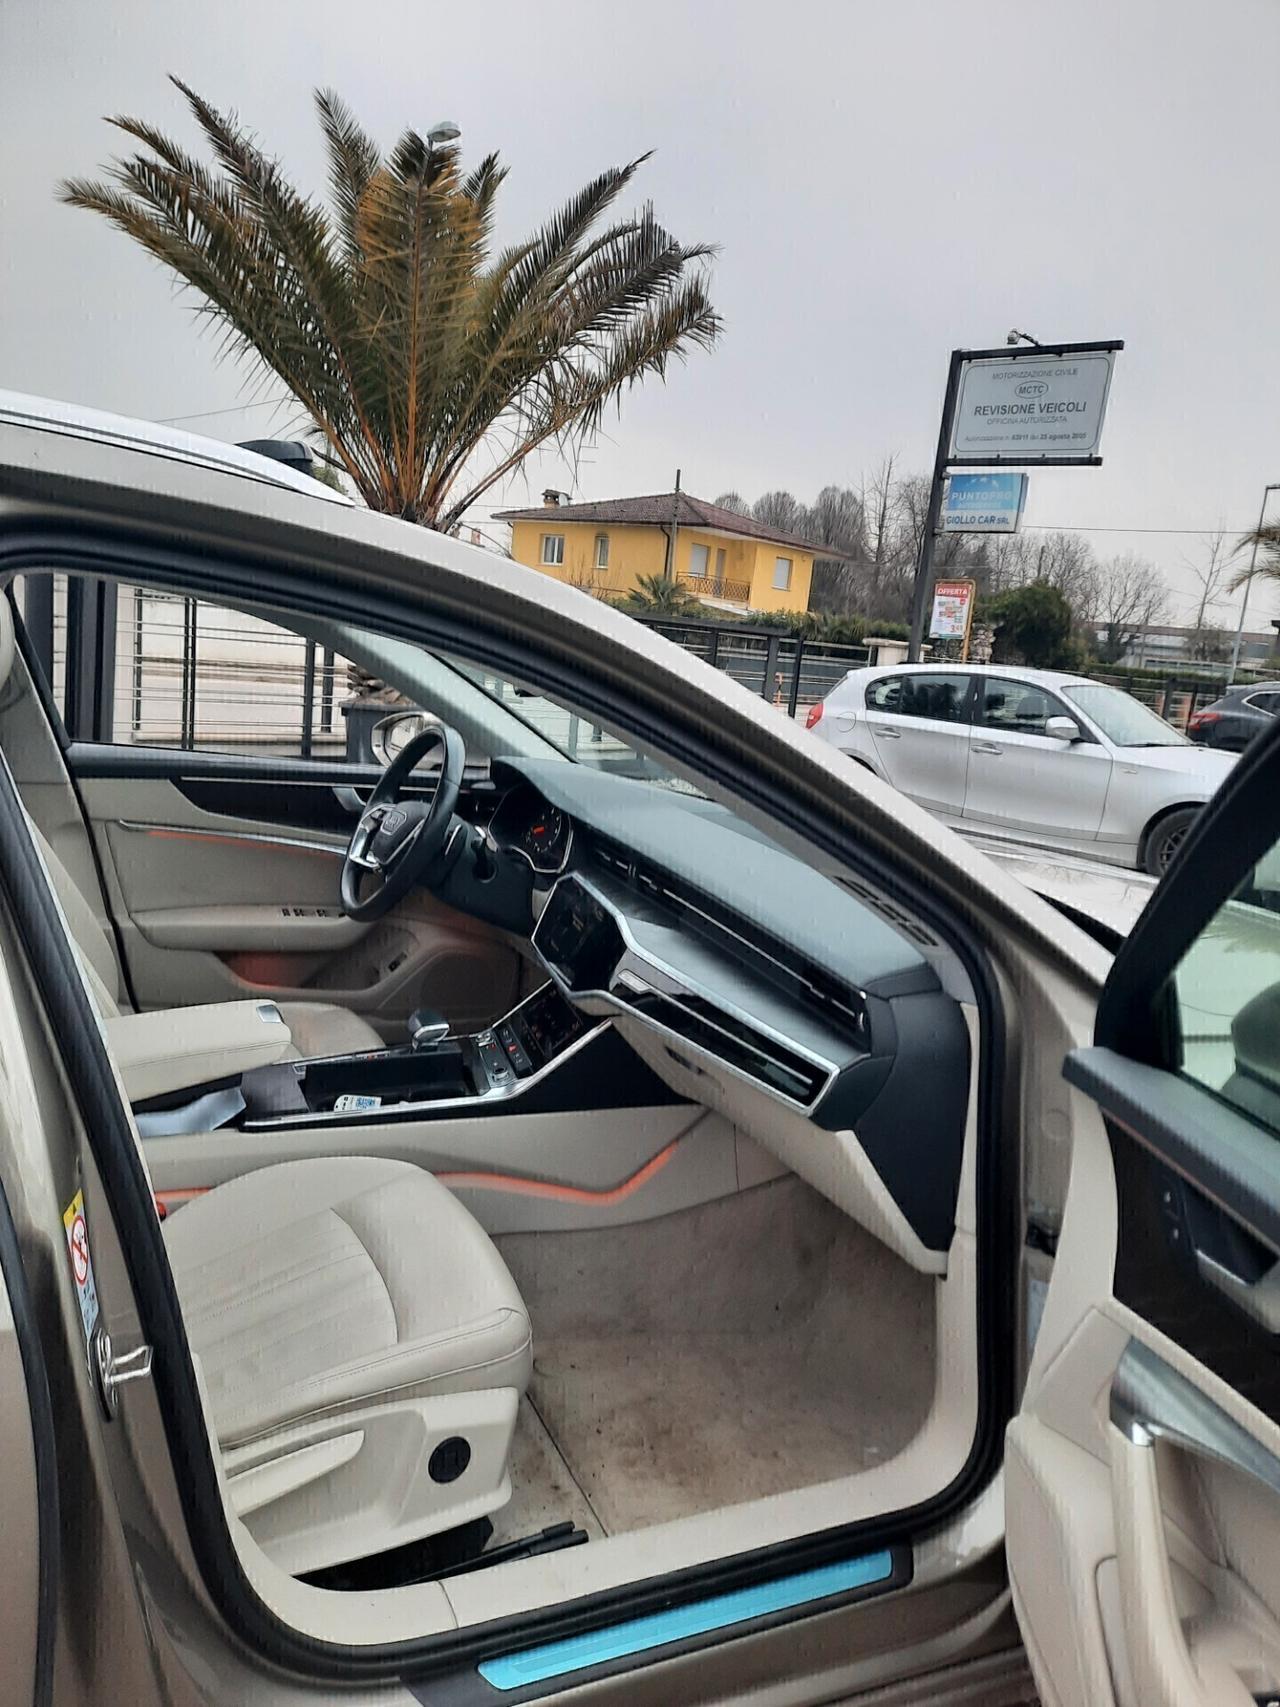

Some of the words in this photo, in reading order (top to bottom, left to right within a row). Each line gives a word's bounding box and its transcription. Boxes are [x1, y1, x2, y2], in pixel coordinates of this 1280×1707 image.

[1018, 385, 1044, 395] MCTC
[974, 403, 1036, 416] REVISIONE
[1038, 401, 1087, 414] VEICOLI
[946, 515, 976, 525] GIOLLO
[977, 515, 996, 524] CAR
